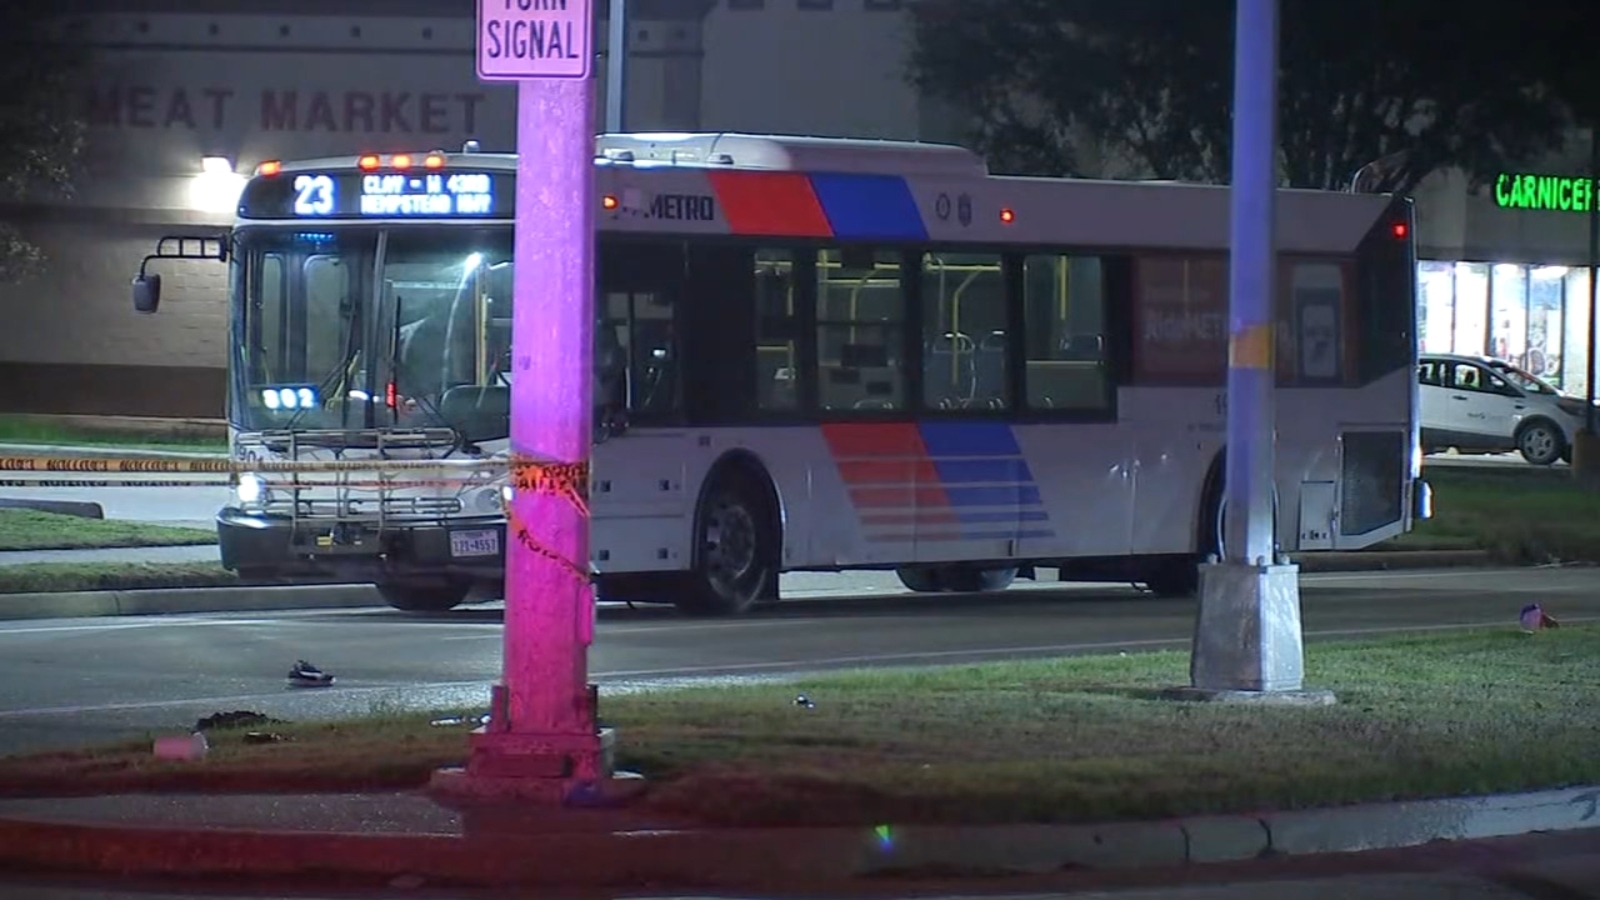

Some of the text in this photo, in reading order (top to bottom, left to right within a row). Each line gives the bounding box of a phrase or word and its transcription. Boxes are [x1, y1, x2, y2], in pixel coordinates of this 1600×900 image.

[488, 19, 579, 60] SIGNAL
[260, 90, 485, 134] MARKET
[294, 175, 334, 214] 23
[649, 193, 715, 221] METRO
